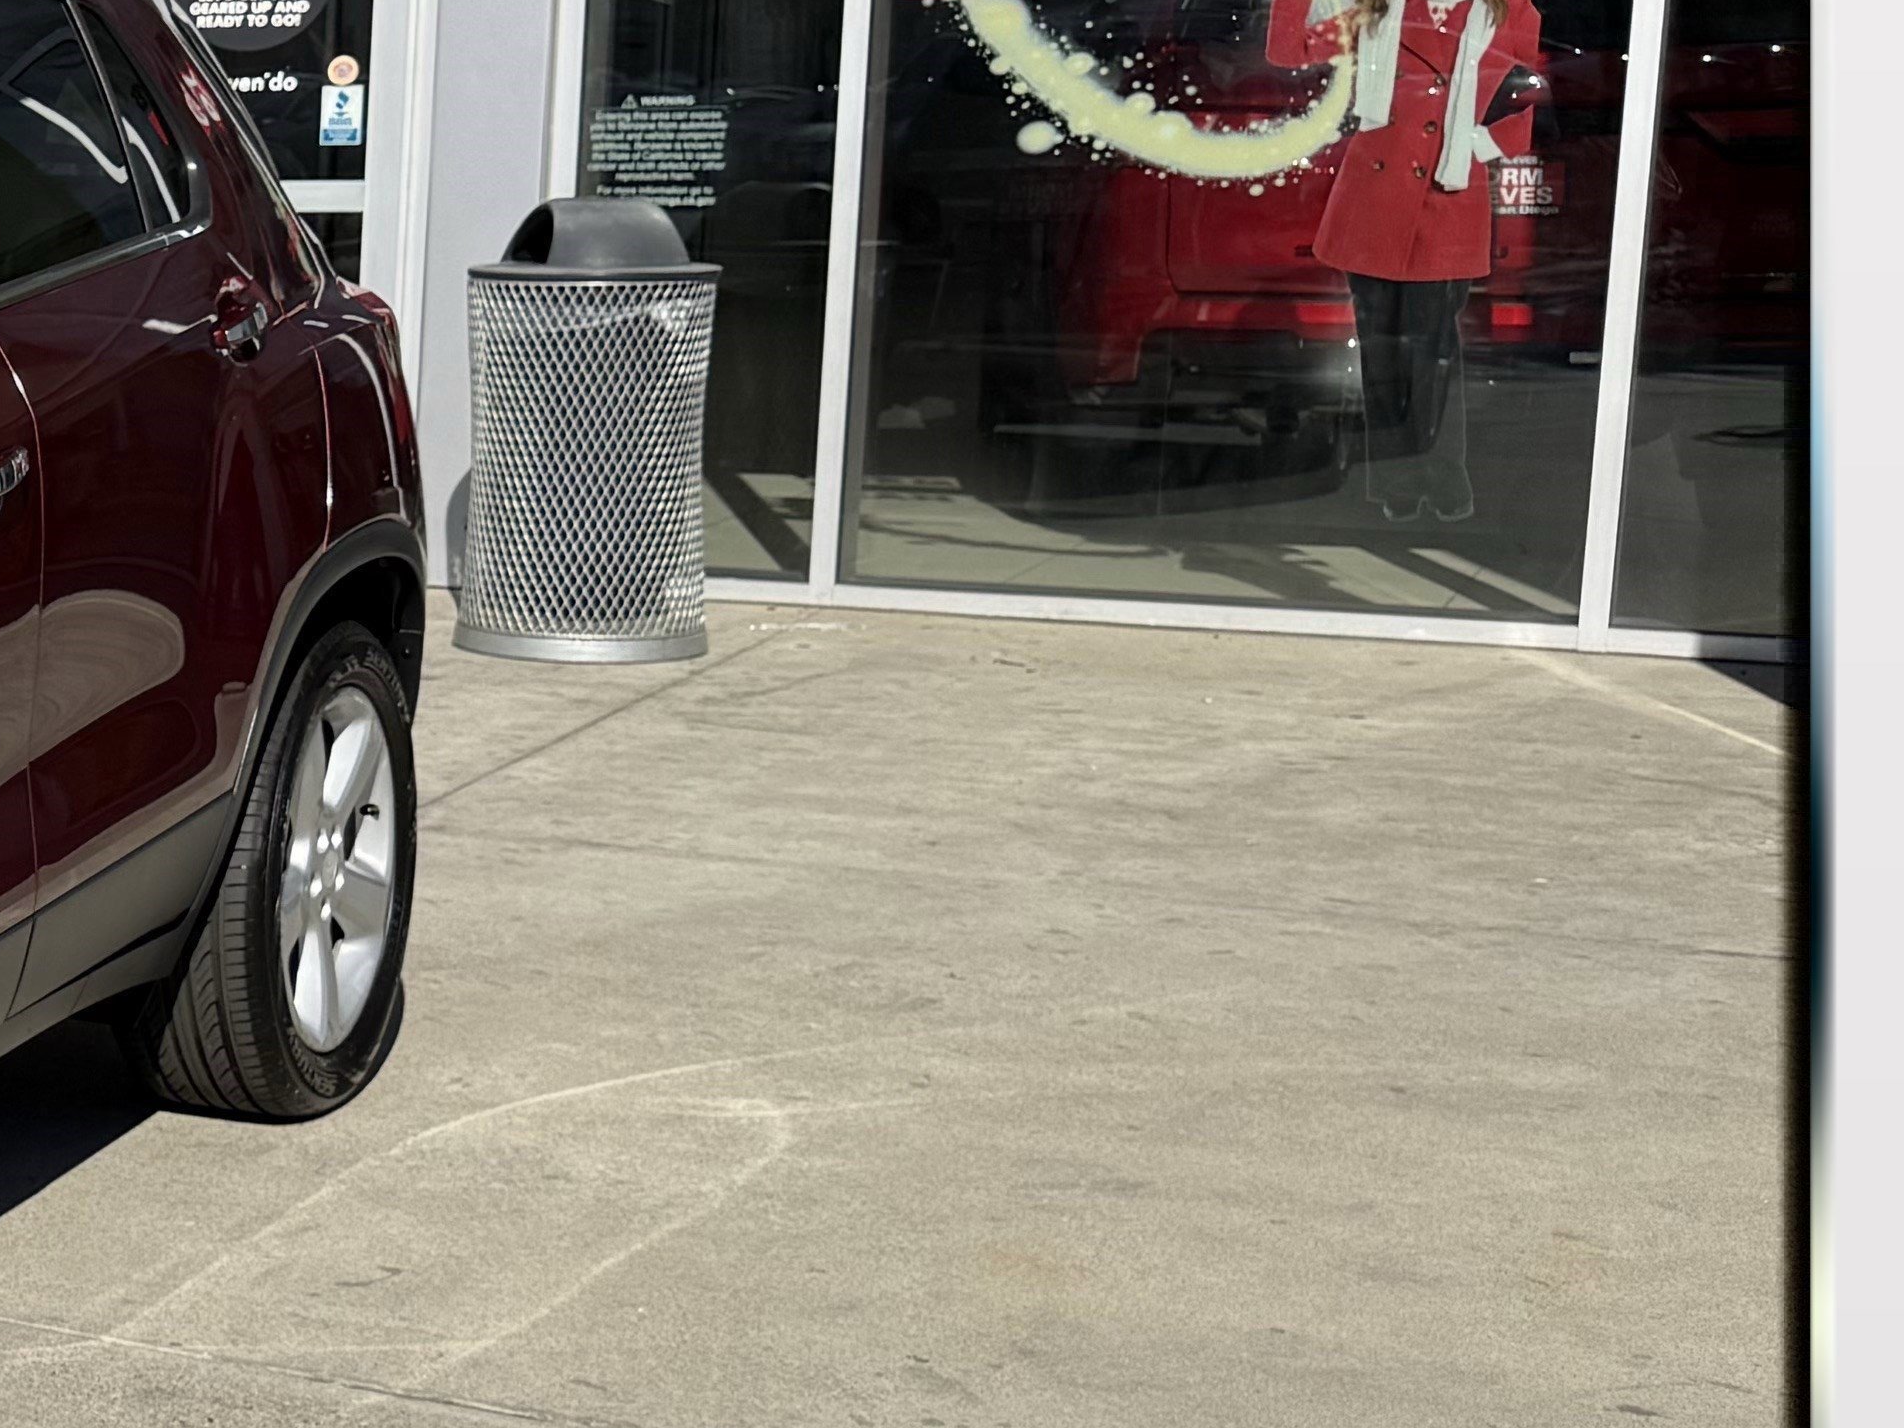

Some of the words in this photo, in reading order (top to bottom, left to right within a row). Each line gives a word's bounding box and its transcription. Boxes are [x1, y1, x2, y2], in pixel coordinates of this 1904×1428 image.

[189, 2, 248, 16] GEARED
[251, 1, 273, 14] UP
[274, 0, 310, 13] AND
[196, 15, 245, 29] READY
[246, 14, 268, 27] TO
[271, 14, 301, 27] GO!
[640, 94, 696, 106] WARNING
